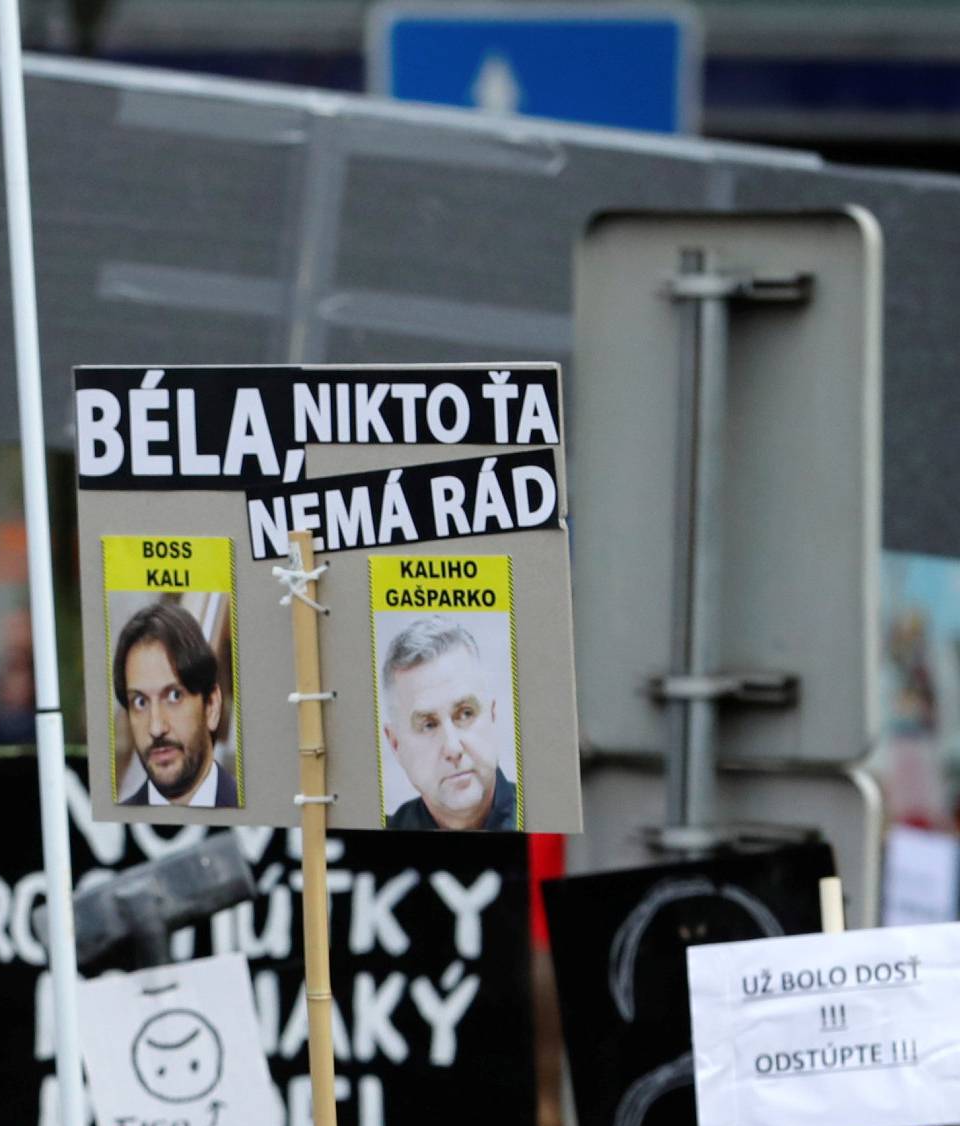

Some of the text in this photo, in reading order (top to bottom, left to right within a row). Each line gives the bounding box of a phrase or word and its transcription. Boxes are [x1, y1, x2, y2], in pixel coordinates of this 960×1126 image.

[76, 370, 560, 483] BÉLA, NIKTO ŤA
[248, 457, 557, 559] NEMÁ RÁD
[143, 541, 192, 559] BOSS
[146, 569, 190, 587] KALI
[400, 560, 478, 579] KALIHO
[385, 584, 497, 607] GAŠPARKO
[742, 955, 921, 995] UŽ BOLO DOSŤ
[820, 1004, 846, 1029] !!!
[755, 1039, 917, 1074] ODSTÚPTE !!!
